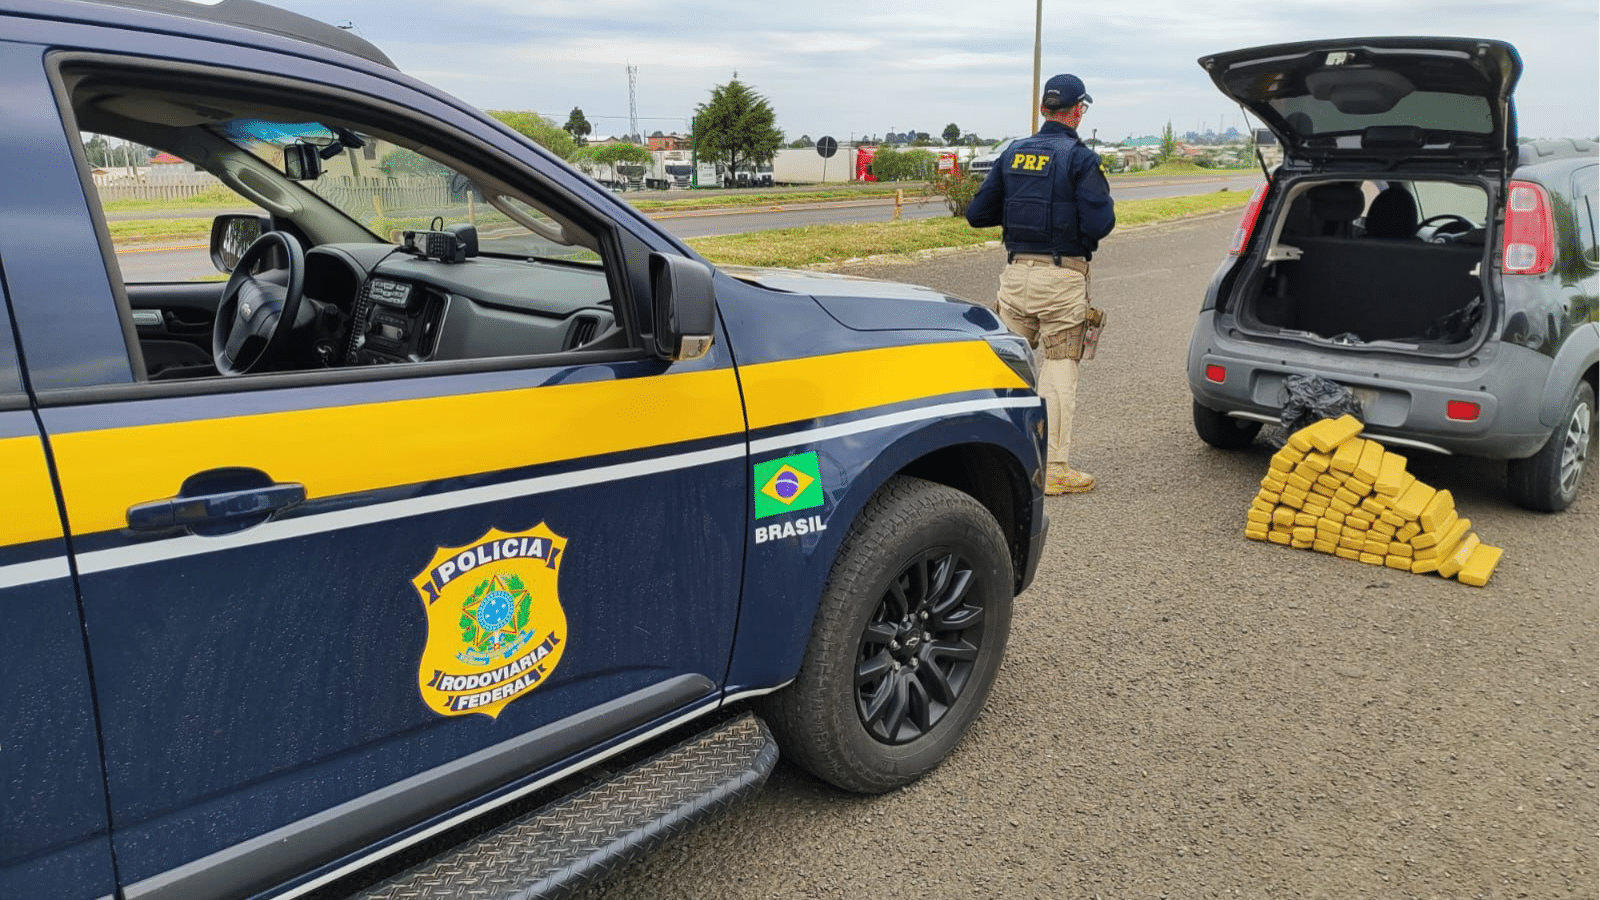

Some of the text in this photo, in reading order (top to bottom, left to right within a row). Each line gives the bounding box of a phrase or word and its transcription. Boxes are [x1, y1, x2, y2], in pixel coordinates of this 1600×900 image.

[1012, 154, 1050, 171] PRF
[755, 515, 827, 545] BRASIL
[457, 674, 536, 710] FEDERAL
